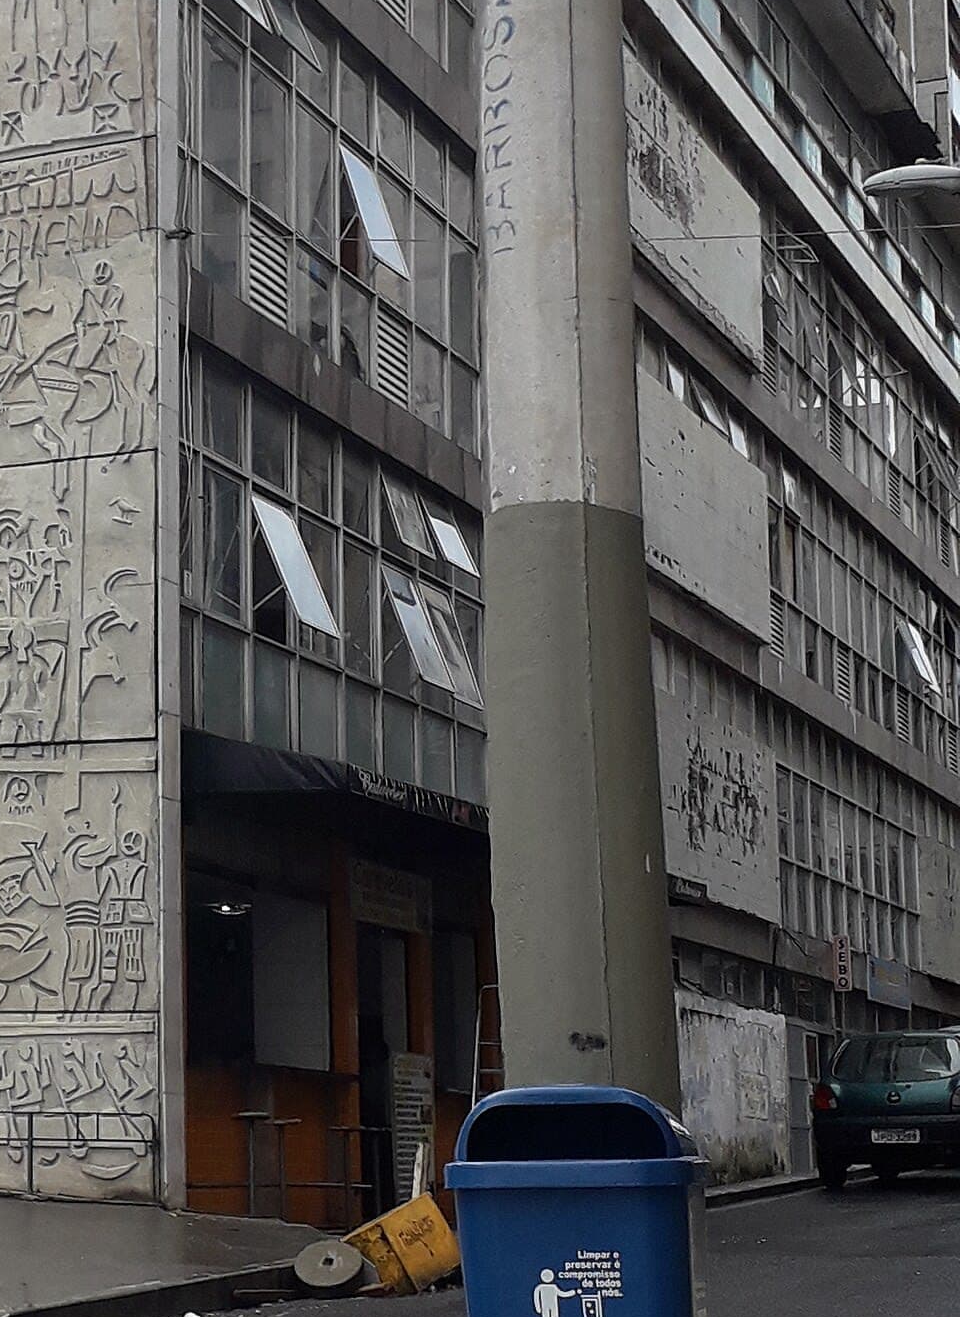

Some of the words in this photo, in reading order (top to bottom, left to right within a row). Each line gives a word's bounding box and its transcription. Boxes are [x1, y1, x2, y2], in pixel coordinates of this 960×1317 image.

[838, 939, 848, 987] SEBO
[577, 1250, 611, 1260] Limpar
[558, 1270, 621, 1280] compromisso
[581, 1279, 594, 1288] de
[596, 1279, 622, 1288] todos
